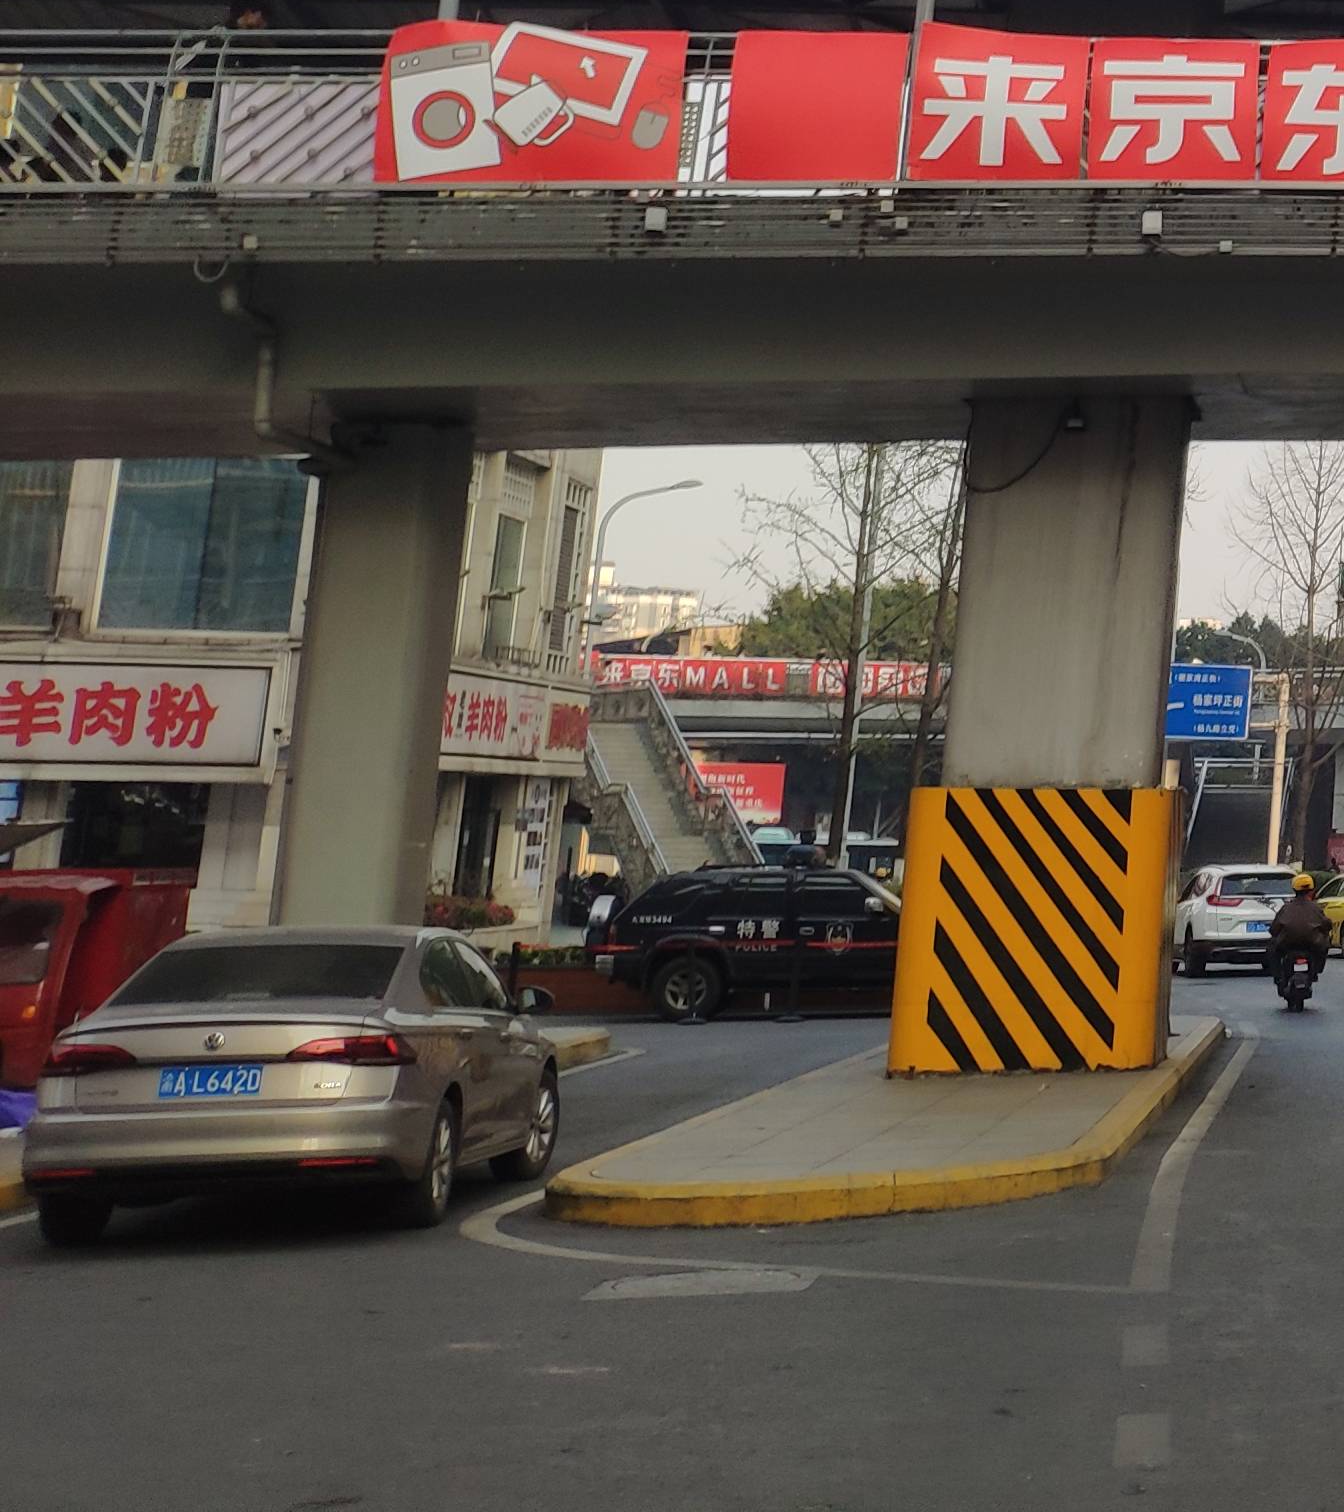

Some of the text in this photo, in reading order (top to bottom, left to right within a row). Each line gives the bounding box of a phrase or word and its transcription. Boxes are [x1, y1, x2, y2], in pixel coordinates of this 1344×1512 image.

[0, 679, 219, 749] 羊肉粉
[737, 920, 780, 939] 特警
[735, 944, 777, 952] POLICE
